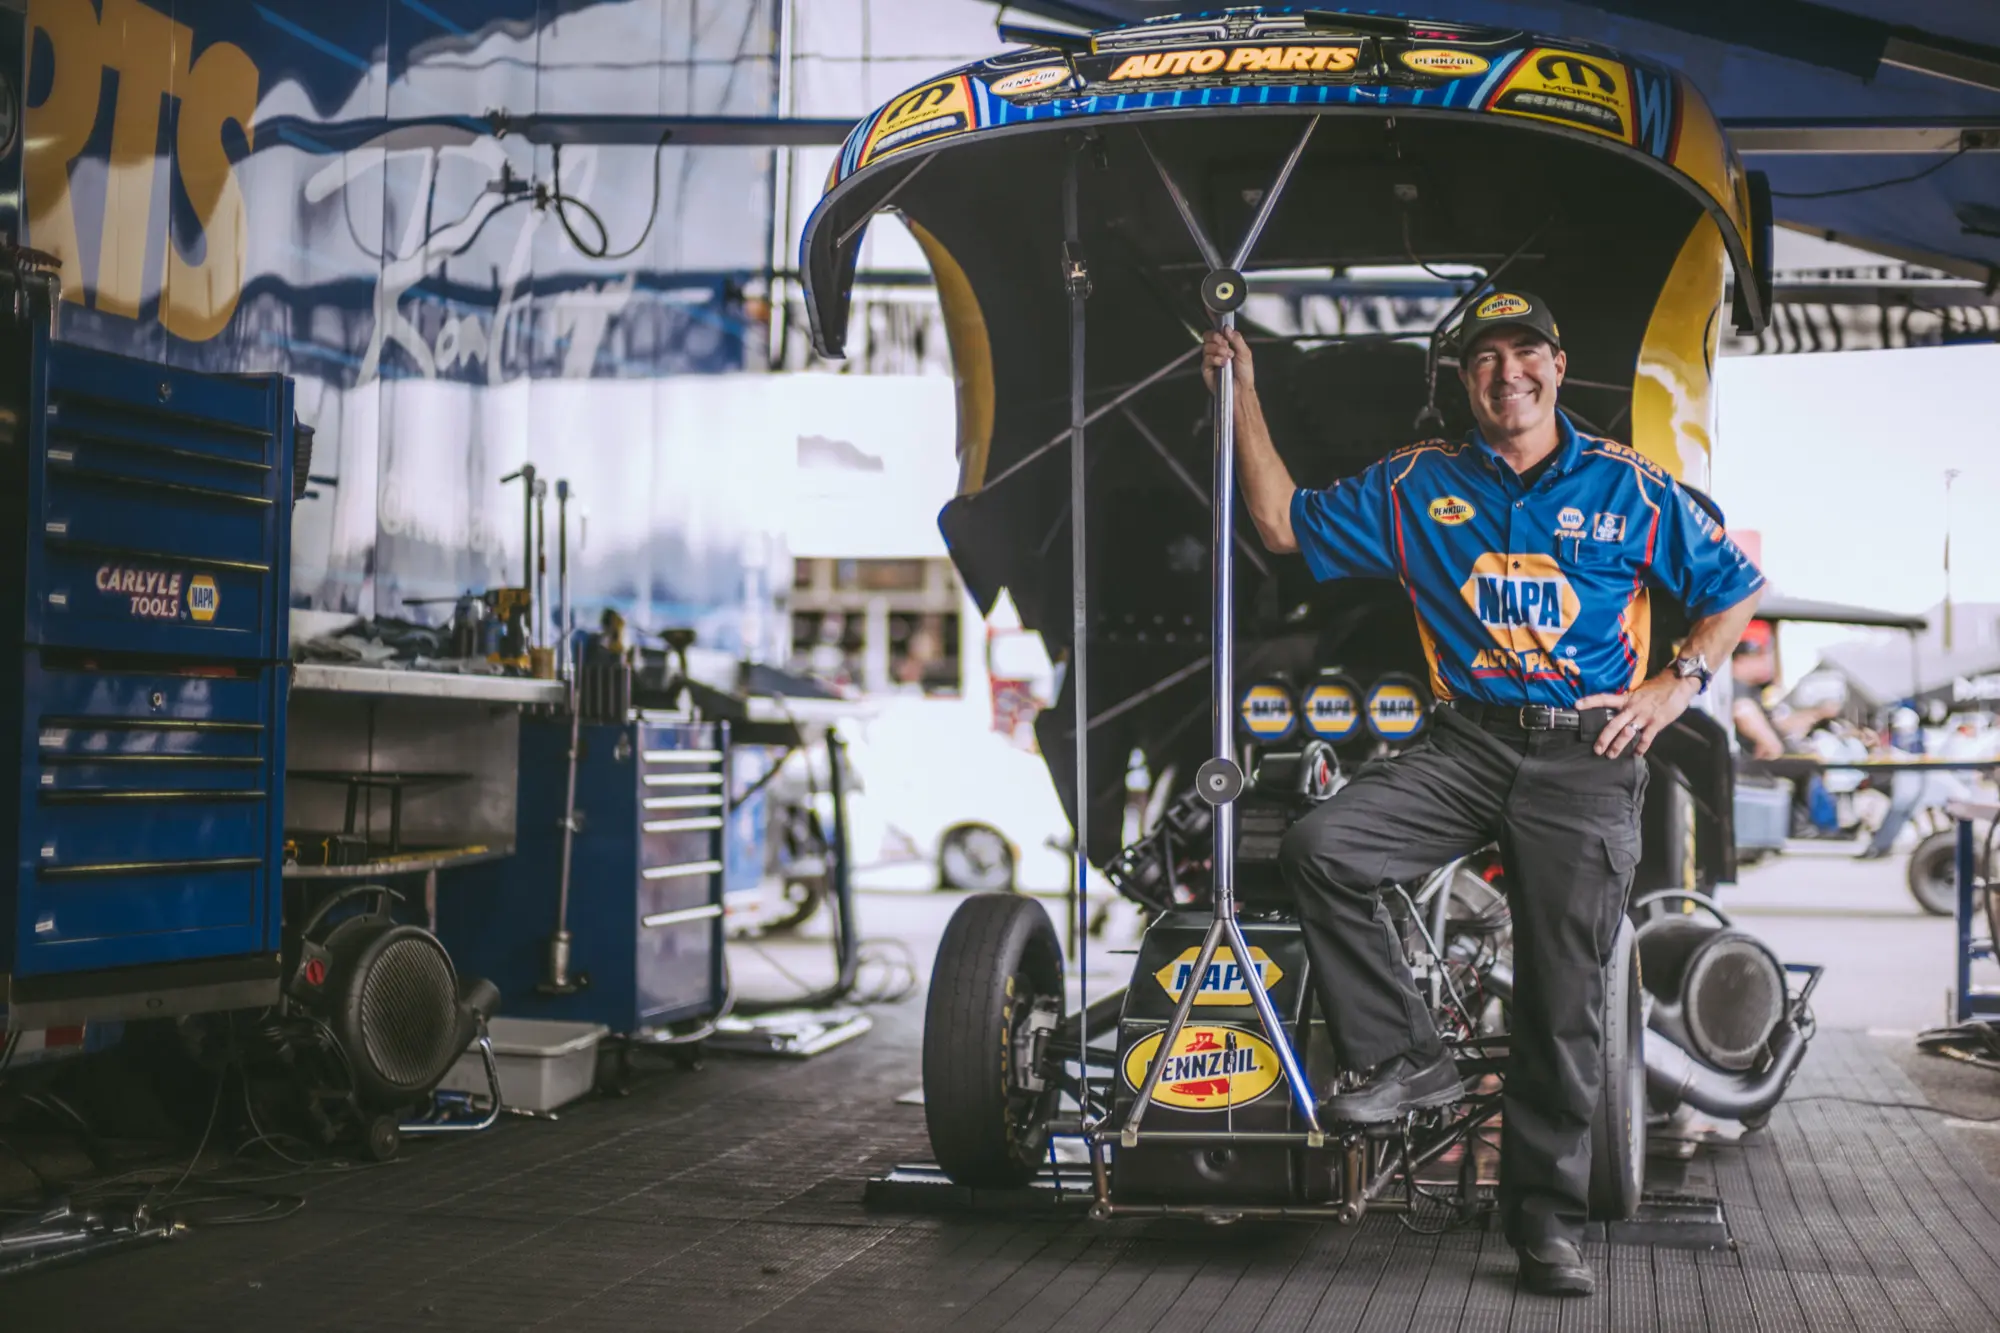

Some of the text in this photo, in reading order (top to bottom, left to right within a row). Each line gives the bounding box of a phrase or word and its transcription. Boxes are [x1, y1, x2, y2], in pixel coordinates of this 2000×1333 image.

[1108, 47, 1359, 81] AUTO PARTS
[1414, 57, 1474, 66] PENNZOIL
[1000, 71, 1056, 90] PENNZOIL
[1542, 82, 1622, 108] MOPAR
[1481, 299, 1522, 315] PENNZOIL
[1604, 441, 1664, 479] NAPA
[1433, 505, 1467, 516] PENNZOIL
[1562, 513, 1580, 524] NAPA
[95, 566, 180, 596] CARLYLE
[130, 596, 178, 617] TOOLS
[191, 586, 213, 609] NAPA
[1478, 577, 1561, 628] NAPA
[1146, 1048, 1257, 1082] ENNZOIL
